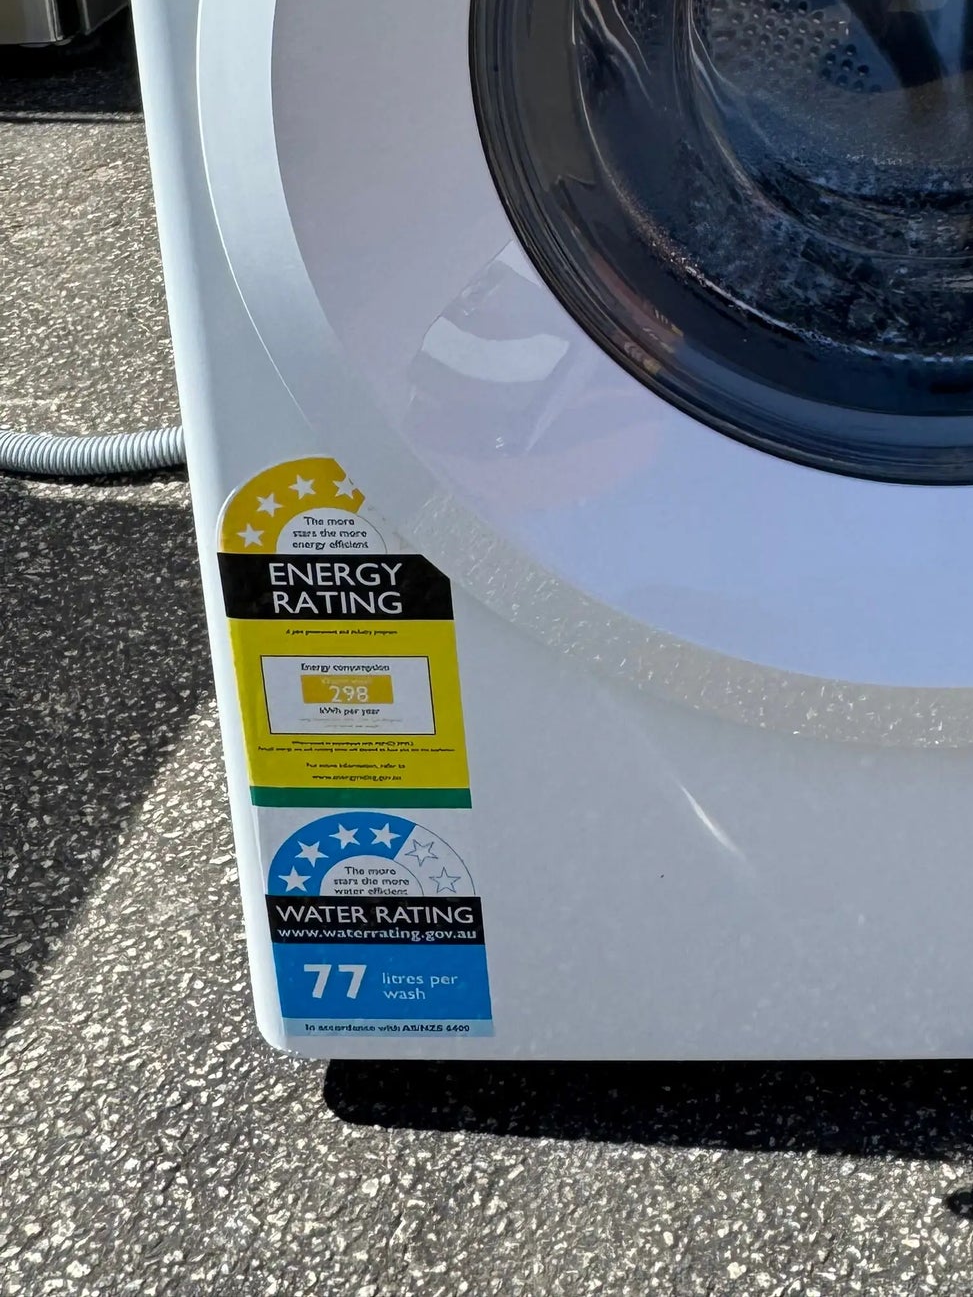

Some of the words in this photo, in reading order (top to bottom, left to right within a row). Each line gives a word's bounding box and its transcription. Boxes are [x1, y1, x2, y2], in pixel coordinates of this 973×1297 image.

[303, 516, 324, 526] The
[327, 518, 355, 526] more
[320, 529, 336, 538] the
[292, 541, 326, 550] energy
[268, 562, 402, 586] ENERGY
[273, 591, 403, 614] RATING
[301, 663, 331, 672] Energy
[330, 684, 369, 703] 298
[344, 708, 360, 716] per
[362, 708, 380, 716] year
[344, 866, 365, 875] The
[276, 905, 368, 923] WATER
[375, 906, 474, 924] RATING
[277, 928, 476, 942] www.waterrating.gov.au
[304, 964, 367, 999] 77
[382, 972, 424, 985] litres
[431, 974, 458, 989] per
[382, 989, 426, 1000] wash
